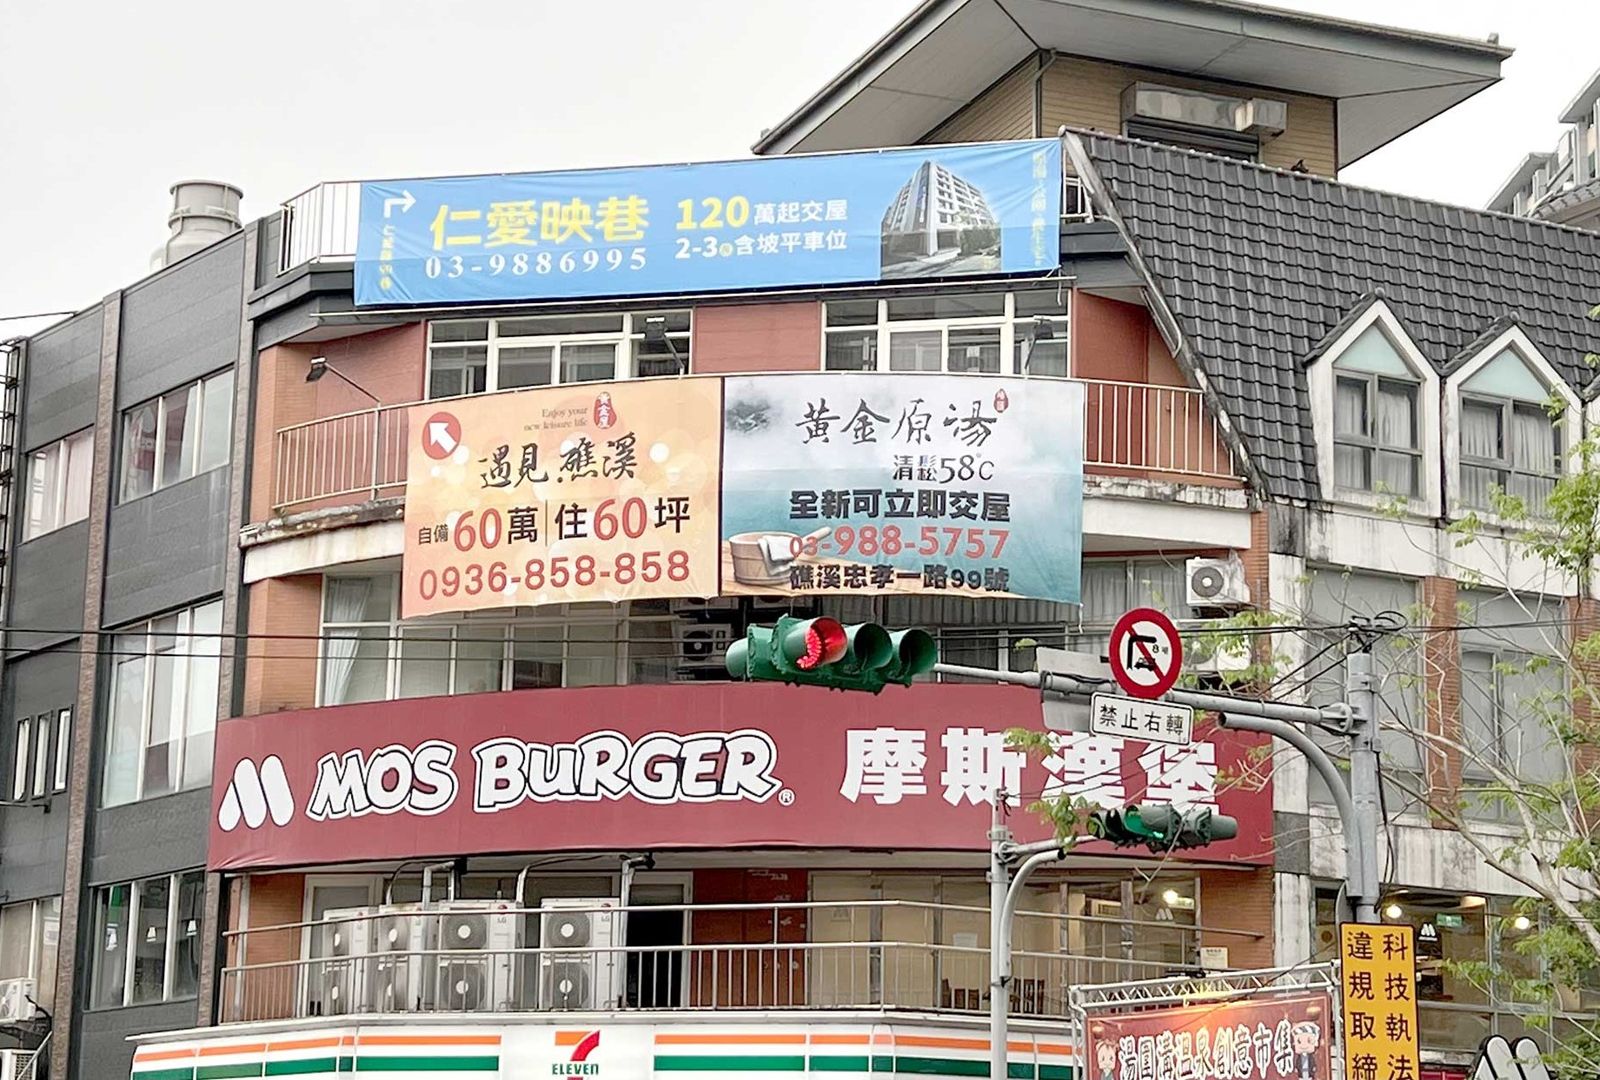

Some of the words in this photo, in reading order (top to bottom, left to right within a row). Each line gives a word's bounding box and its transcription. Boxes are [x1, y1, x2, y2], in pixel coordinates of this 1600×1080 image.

[430, 195, 649, 251] 仁愛映巷
[425, 247, 647, 279] 03-9886995
[789, 488, 1011, 522] 全新可立即交屋
[789, 525, 1010, 560] 03-988-5757
[419, 549, 690, 601] 0936-858-858
[789, 564, 1010, 592] 礁溪忠孝一路99號
[1099, 703, 1184, 736] 禁止右轉
[305, 738, 459, 821] MOS
[839, 727, 1220, 815] 摩斯漢堡
[1347, 931, 1378, 1080] 違規取締
[1382, 932, 1414, 1080] 科技執法
